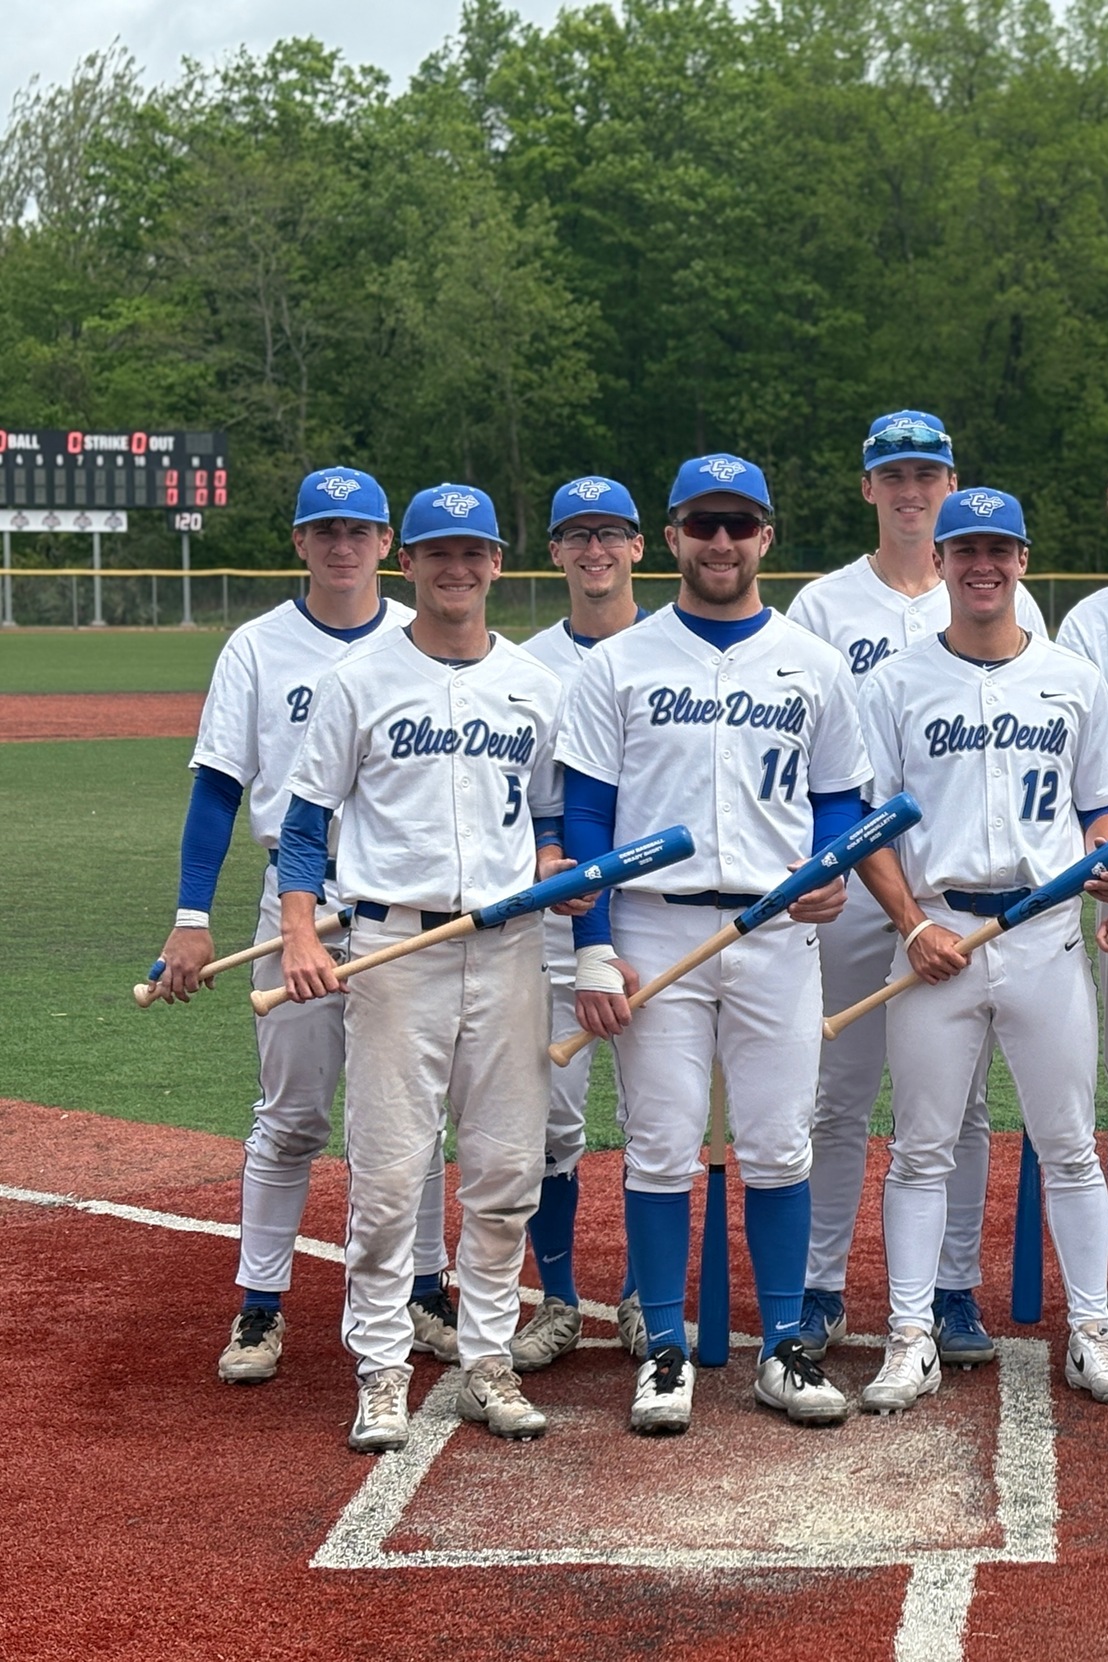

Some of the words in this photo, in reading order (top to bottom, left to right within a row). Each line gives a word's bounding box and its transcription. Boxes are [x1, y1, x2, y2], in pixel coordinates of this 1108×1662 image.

[7, 434, 40, 450] BALL
[67, 431, 83, 454] 0
[84, 434, 129, 451] STRIKE
[131, 432, 147, 454] 0
[149, 436, 175, 452] OUT
[175, 512, 202, 531] 120
[650, 687, 724, 726] Blue
[725, 690, 806, 736] Devils
[388, 715, 461, 759] Blue
[461, 718, 536, 766] Devils
[925, 714, 991, 758] Blue
[992, 713, 1067, 756] Devils
[757, 748, 800, 803] 14
[502, 773, 522, 827] 5
[1019, 768, 1059, 822] 12
